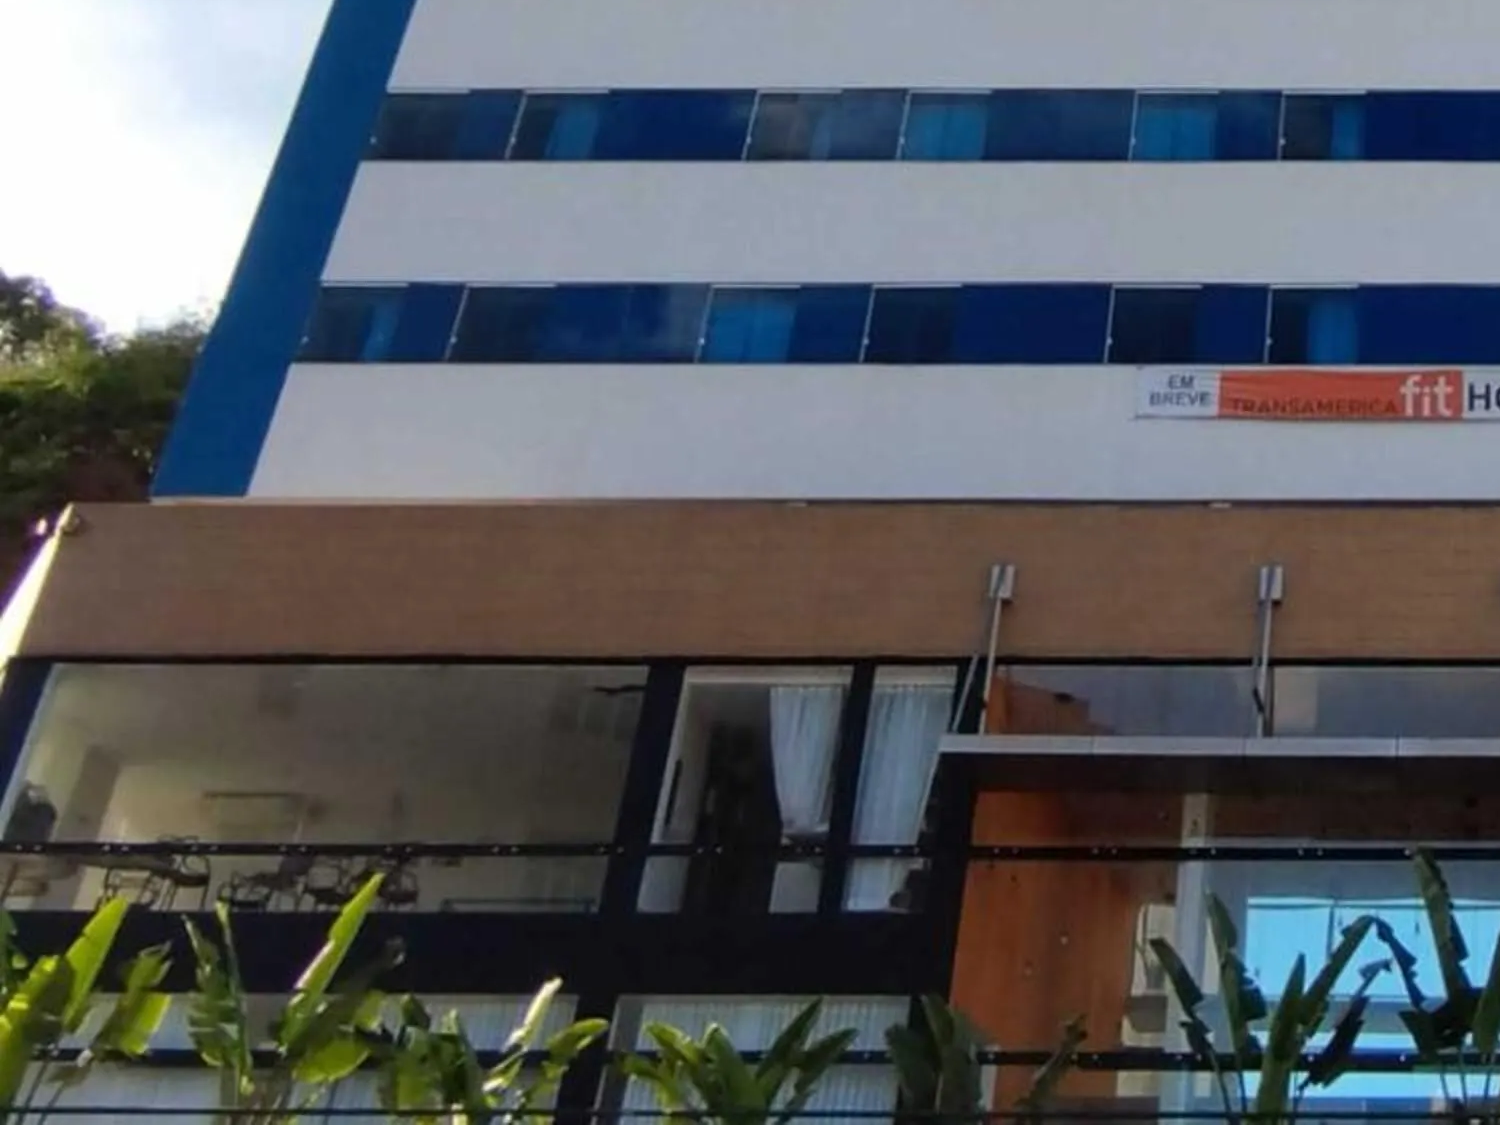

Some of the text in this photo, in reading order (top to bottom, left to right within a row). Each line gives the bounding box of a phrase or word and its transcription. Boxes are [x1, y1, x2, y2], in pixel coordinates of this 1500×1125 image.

[1168, 375, 1195, 389] EM
[1149, 391, 1210, 407] BREVE
[1231, 398, 1398, 416] TRANSAMERICA
[1400, 374, 1453, 418] fit
